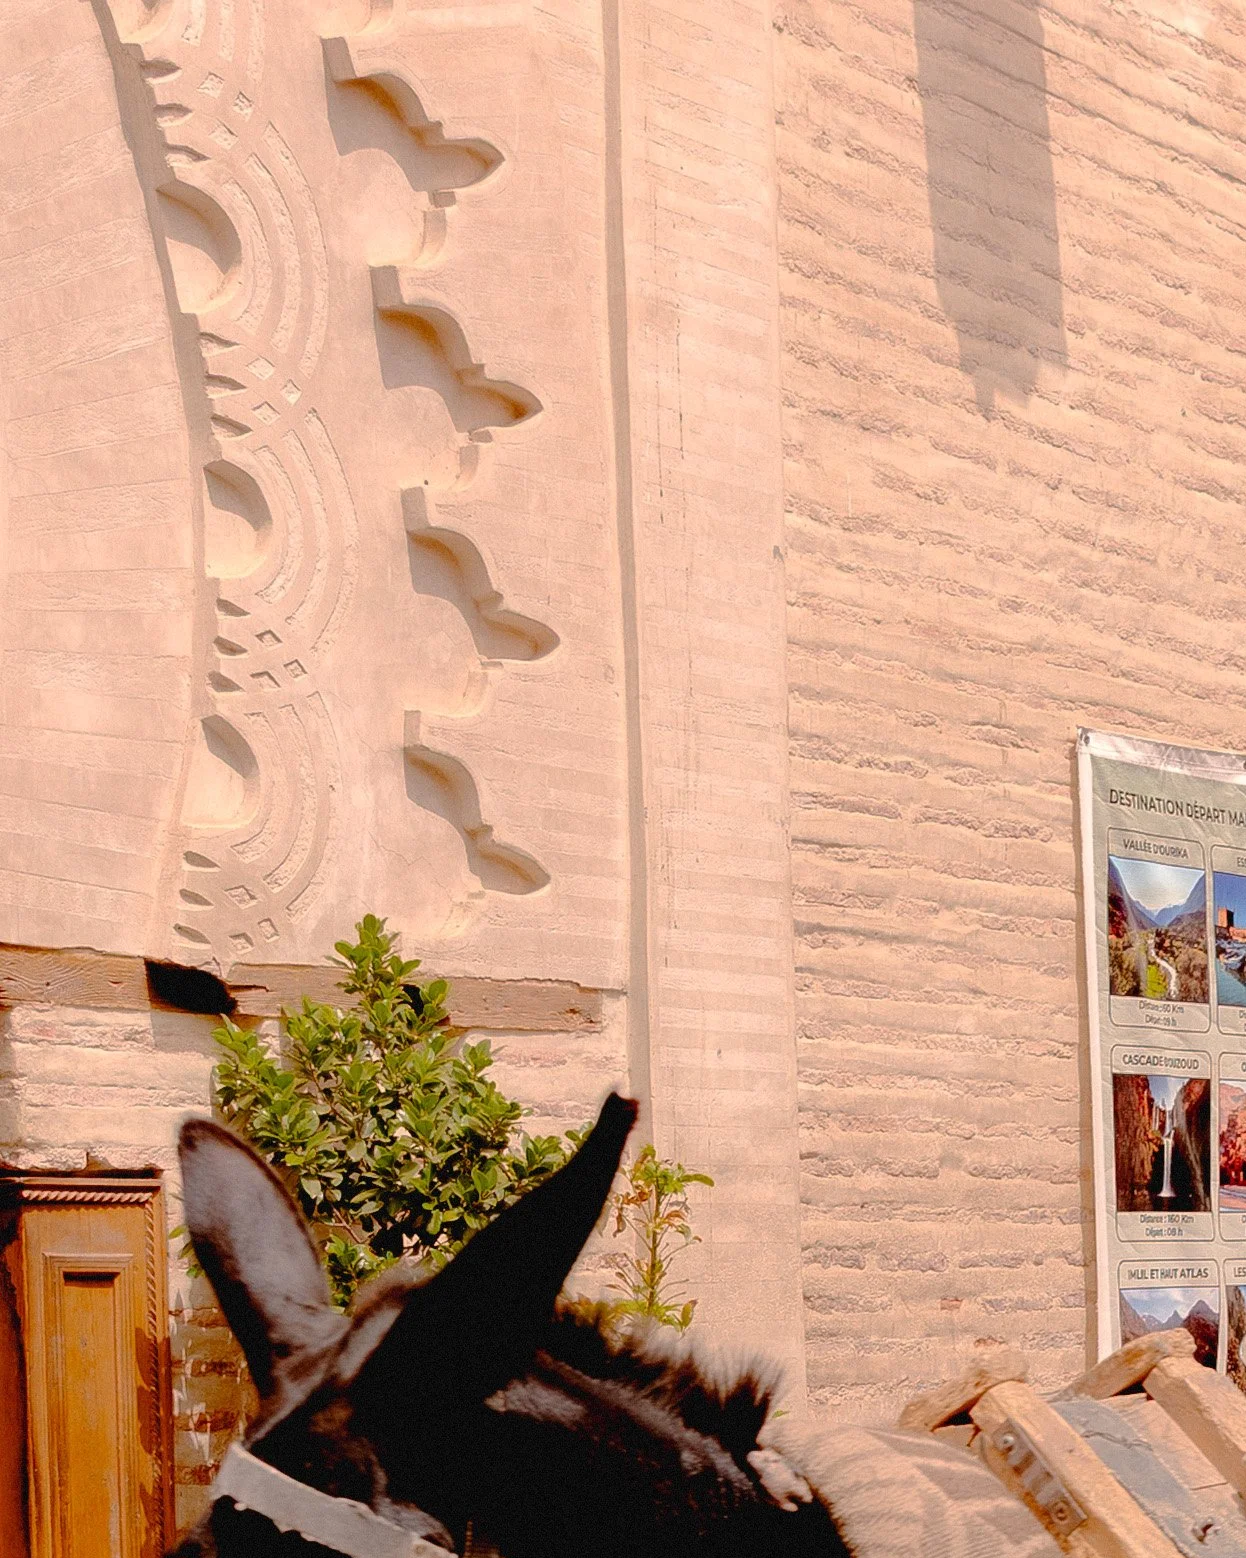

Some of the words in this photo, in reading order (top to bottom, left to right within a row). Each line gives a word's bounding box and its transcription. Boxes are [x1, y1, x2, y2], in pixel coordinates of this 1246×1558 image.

[1109, 788, 1184, 816] DESTINATION
[1186, 802, 1226, 825] DÉPART
[1123, 838, 1152, 854] VALLÉE
[1122, 1054, 1164, 1066] CASCADE
[1150, 1269, 1160, 1279] ET
[1179, 1268, 1209, 1279] ATLAS
[1233, 1266, 1246, 1278] LES
